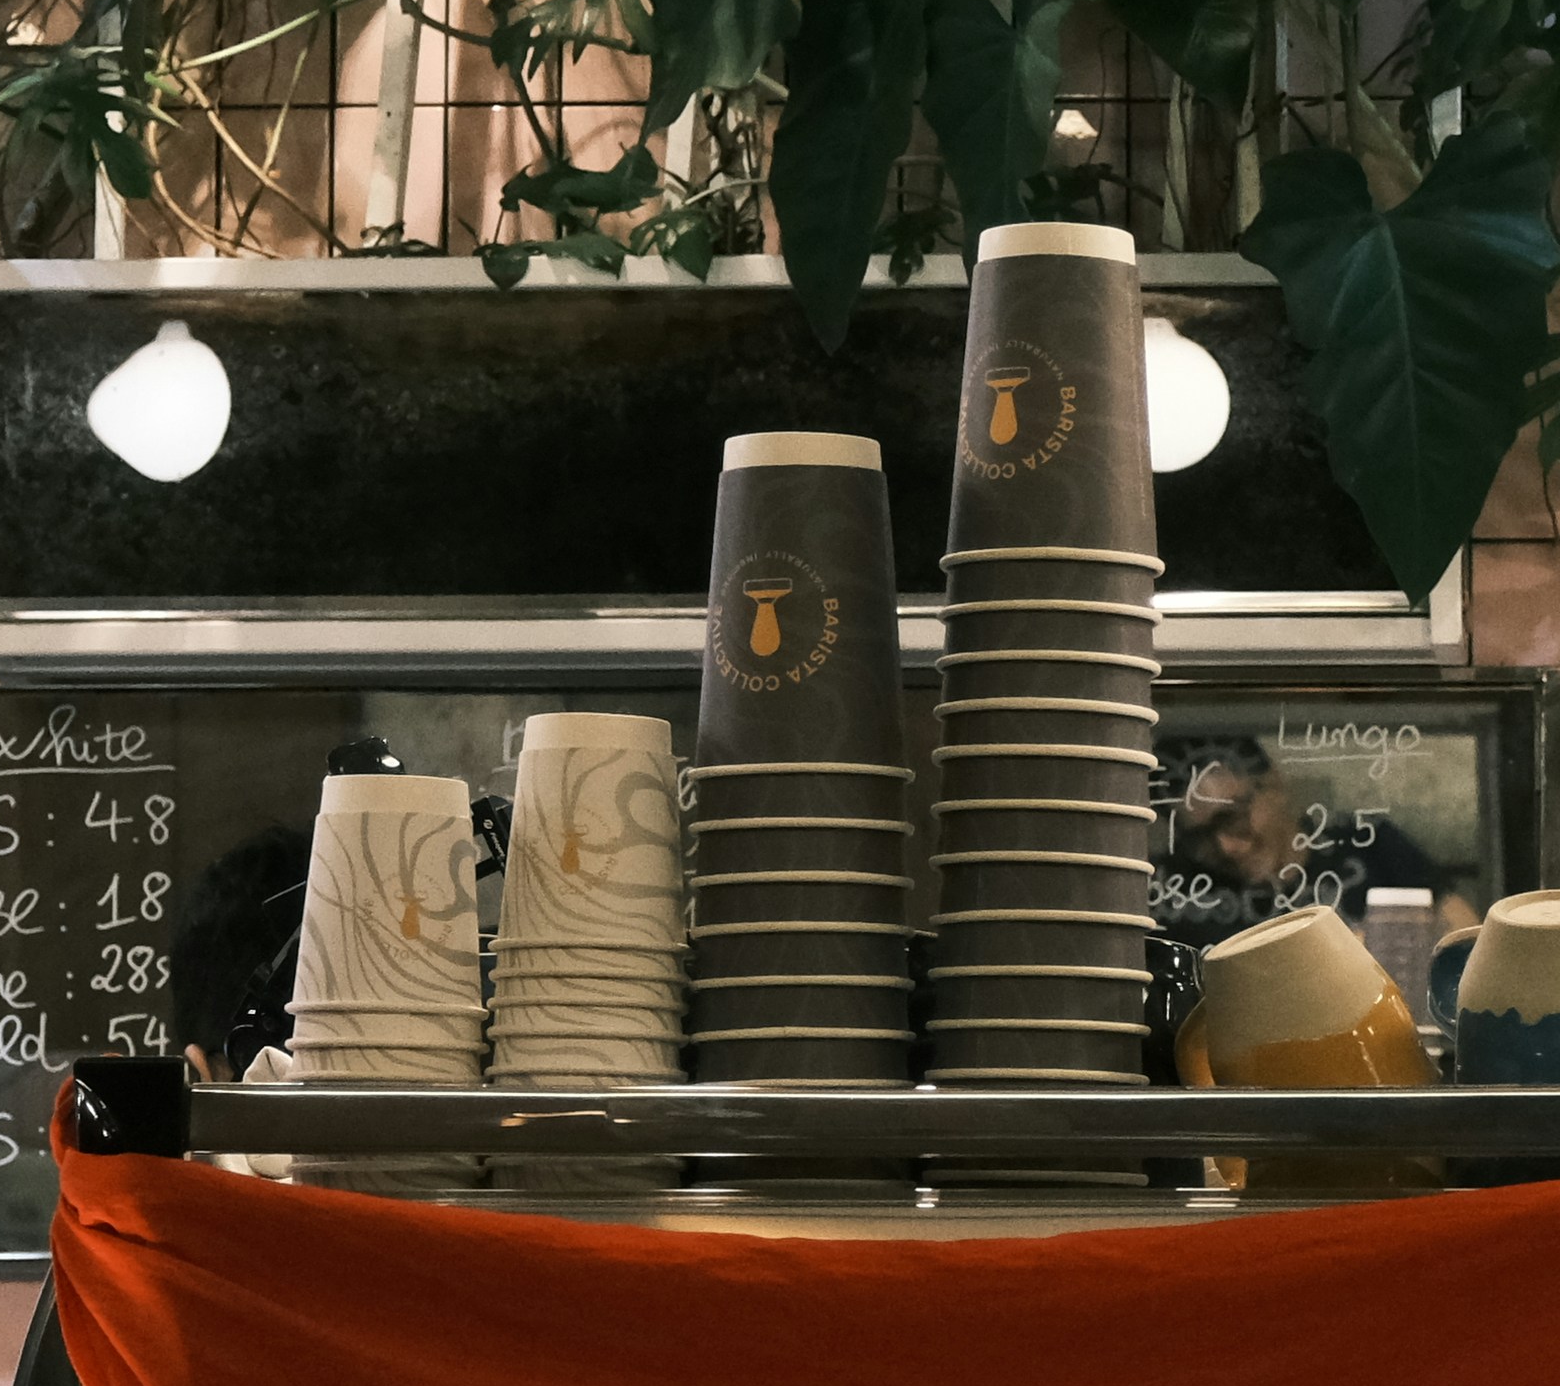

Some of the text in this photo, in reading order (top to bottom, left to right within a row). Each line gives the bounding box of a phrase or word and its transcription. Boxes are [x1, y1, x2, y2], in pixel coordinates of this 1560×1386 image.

[1021, 385, 1077, 471] BARISTA
[711, 597, 839, 692] BARISTA COLLECTIVE
[1278, 714, 1421, 781] Lungo
[84, 791, 176, 846] 4.8
[1291, 802, 1391, 852] 2.5
[95, 870, 172, 930] 18
[1273, 862, 1343, 912] 20
[90, 943, 171, 994] 28s
